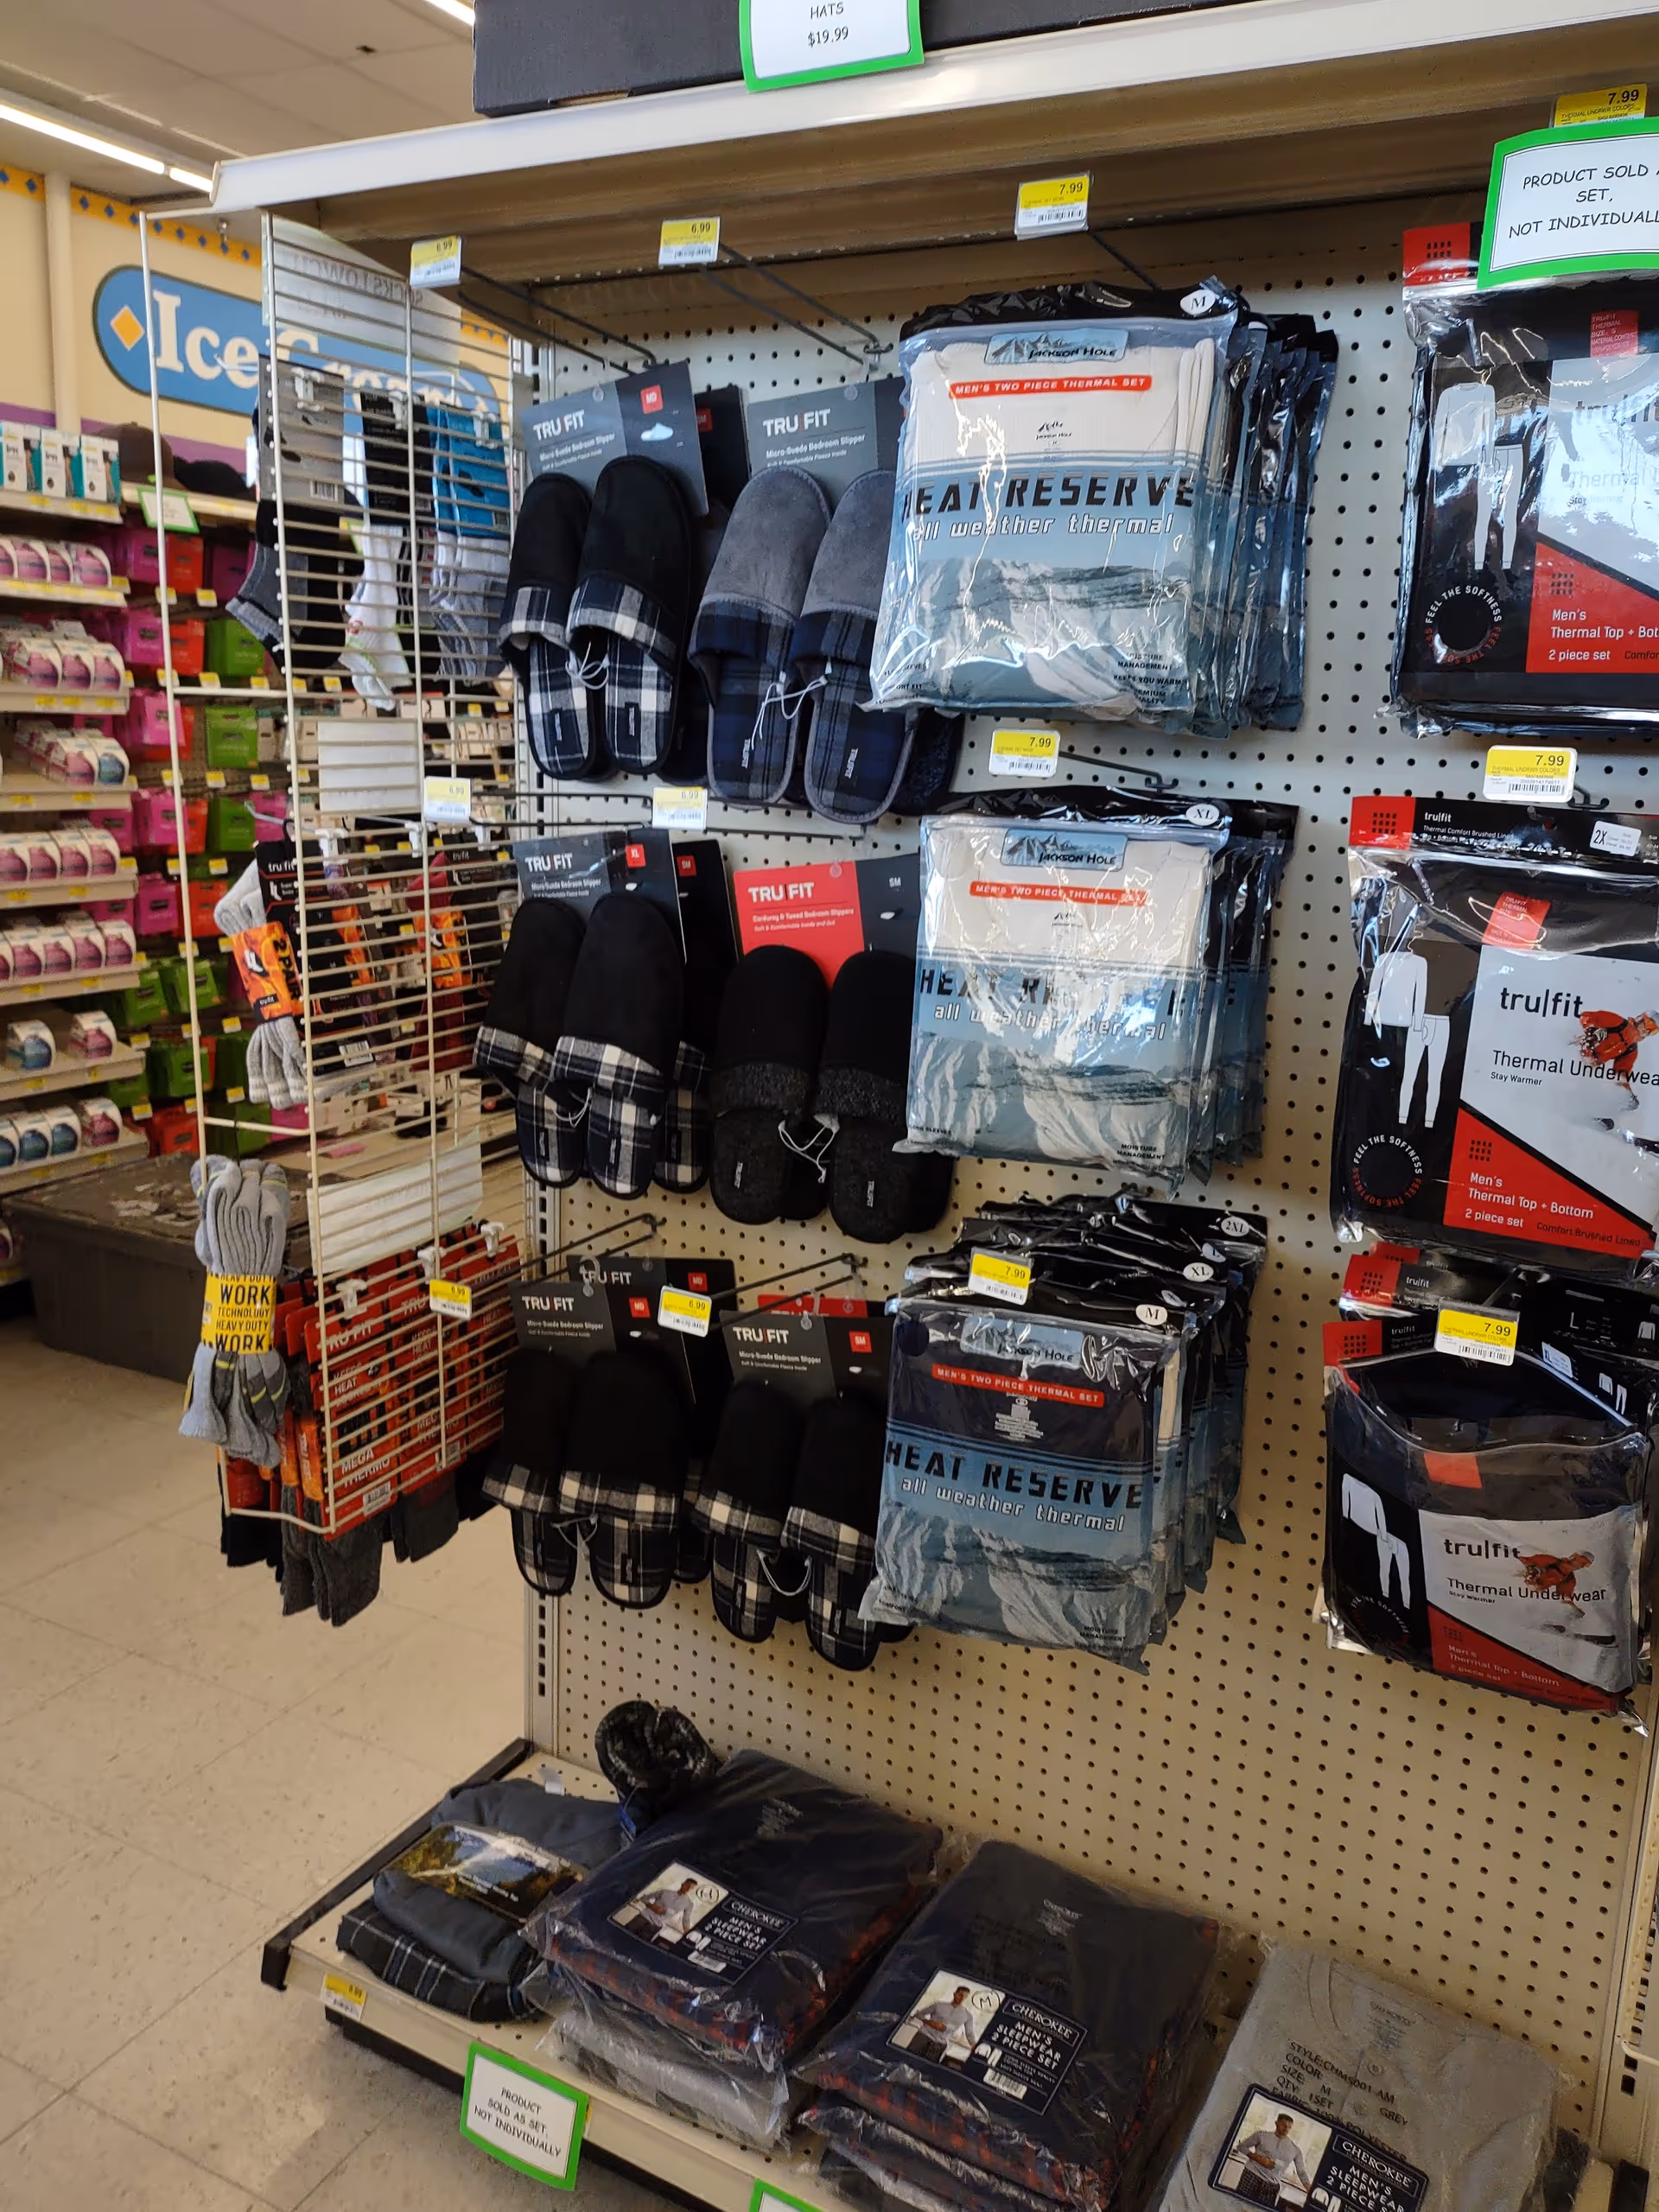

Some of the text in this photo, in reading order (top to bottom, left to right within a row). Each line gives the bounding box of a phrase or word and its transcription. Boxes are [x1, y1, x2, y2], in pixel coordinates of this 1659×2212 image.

[810, 2, 844, 19] HATS
[808, 27, 849, 47] $19.99
[1608, 89, 1640, 105] 7.99
[1522, 164, 1649, 189] PRODUCT SOLD
[1059, 181, 1084, 195] 7.99
[1576, 188, 1613, 202] SET,
[691, 221, 711, 234] 6.99
[1509, 220, 1543, 238] NOT
[435, 239, 454, 251] 6.99
[1190, 295, 1208, 309] M
[152, 289, 259, 390] Ice
[954, 377, 1145, 395] MEN'S TWO PIECE THERMAL SET
[645, 391, 658, 404] MD
[809, 438, 840, 451] Bedroom
[840, 434, 866, 447] Slipper
[1004, 472, 1197, 508] RESERVE
[912, 512, 1174, 541] all weather thermal
[1425, 585, 1503, 623] FEEL THE SOFTNESS
[1552, 608, 1587, 621] Men's
[1551, 626, 1601, 639] Thermal
[1605, 626, 1624, 640] Top
[1548, 649, 1611, 662] 2 piece set
[1117, 660, 1173, 672] MANAGEMENT
[1029, 737, 1052, 748] 7.99
[1535, 754, 1565, 766] 7.99
[681, 790, 699, 799] 6.99
[1193, 808, 1215, 820] XL
[1423, 824, 1497, 838] Thermal Comfort Brushed
[1593, 830, 1608, 845] 2X
[631, 849, 640, 859] XL
[1038, 852, 1116, 865] JACKSON HOLE
[888, 877, 902, 888] SM
[976, 884, 1117, 901] MEN'S TWO PIECE THERMAL
[753, 907, 855, 925] Corduroy Tweed Bedroom Slippers
[935, 1004, 1061, 1032] all weather
[1493, 1049, 1564, 1074] Thermal
[1491, 1071, 1542, 1086] Stay Warmer
[1353, 1134, 1423, 1174] FEEL THE SOFTNESS
[1470, 1172, 1503, 1187] Men's
[1468, 1187, 1594, 1219] Thermal Top Bottom
[1225, 1220, 1246, 1233] 2XL
[1465, 1208, 1641, 1247] 2 piece set Comfort Brushed Lined
[1006, 1266, 1026, 1280] 7.99
[1191, 1266, 1210, 1277] XL
[220, 1283, 270, 1306] WORK
[448, 1286, 466, 1296] 6.99
[218, 1307, 270, 1319] TECHNOLOGY
[688, 1299, 707, 1312] 6.99
[1145, 1306, 1160, 1320] M
[216, 1319, 270, 1332] HEAVY DUTY
[1484, 1322, 1511, 1337] 7.99
[1569, 1312, 1580, 1330] L
[215, 1333, 265, 1353] WORK
[800, 1355, 822, 1364] Slipper
[1044, 1349, 1074, 1363] HOLE
[937, 1367, 967, 1380] MEN'S
[970, 1374, 992, 1384] TWO
[995, 1379, 1024, 1391] PIECE
[1028, 1384, 1076, 1400] THERMAL
[1078, 1393, 1099, 1403] SET
[886, 1440, 1144, 1510] HEAT RESERVE
[901, 1478, 1126, 1533] all weather thermal
[1446, 1576, 1513, 1598] Thermal
[1466, 1594, 1497, 1604] Warmer
[1448, 1652, 1560, 1688] Thermal Top Bottom
[1012, 2004, 1072, 2039] CHEROKEE
[1014, 2021, 1052, 2046] MEN'S
[991, 2031, 1058, 2070] 2 PIECE SET
[996, 2024, 1062, 2063] SLEEPWEAR
[1320, 2084, 1332, 2096] M
[500, 2086, 542, 2116] PRODUCT
[487, 2097, 526, 2125] SOLD AS
[1379, 2107, 1408, 2127] GREY
[474, 2104, 562, 2158] NOT INDIVIDUALLY
[1342, 2140, 1414, 2189] CHEROKEE
[1330, 2165, 1405, 2212] SLEEPWEAR
[1350, 2164, 1392, 2196] MEN'S
[1326, 2175, 1376, 2210] 2 PIECE
